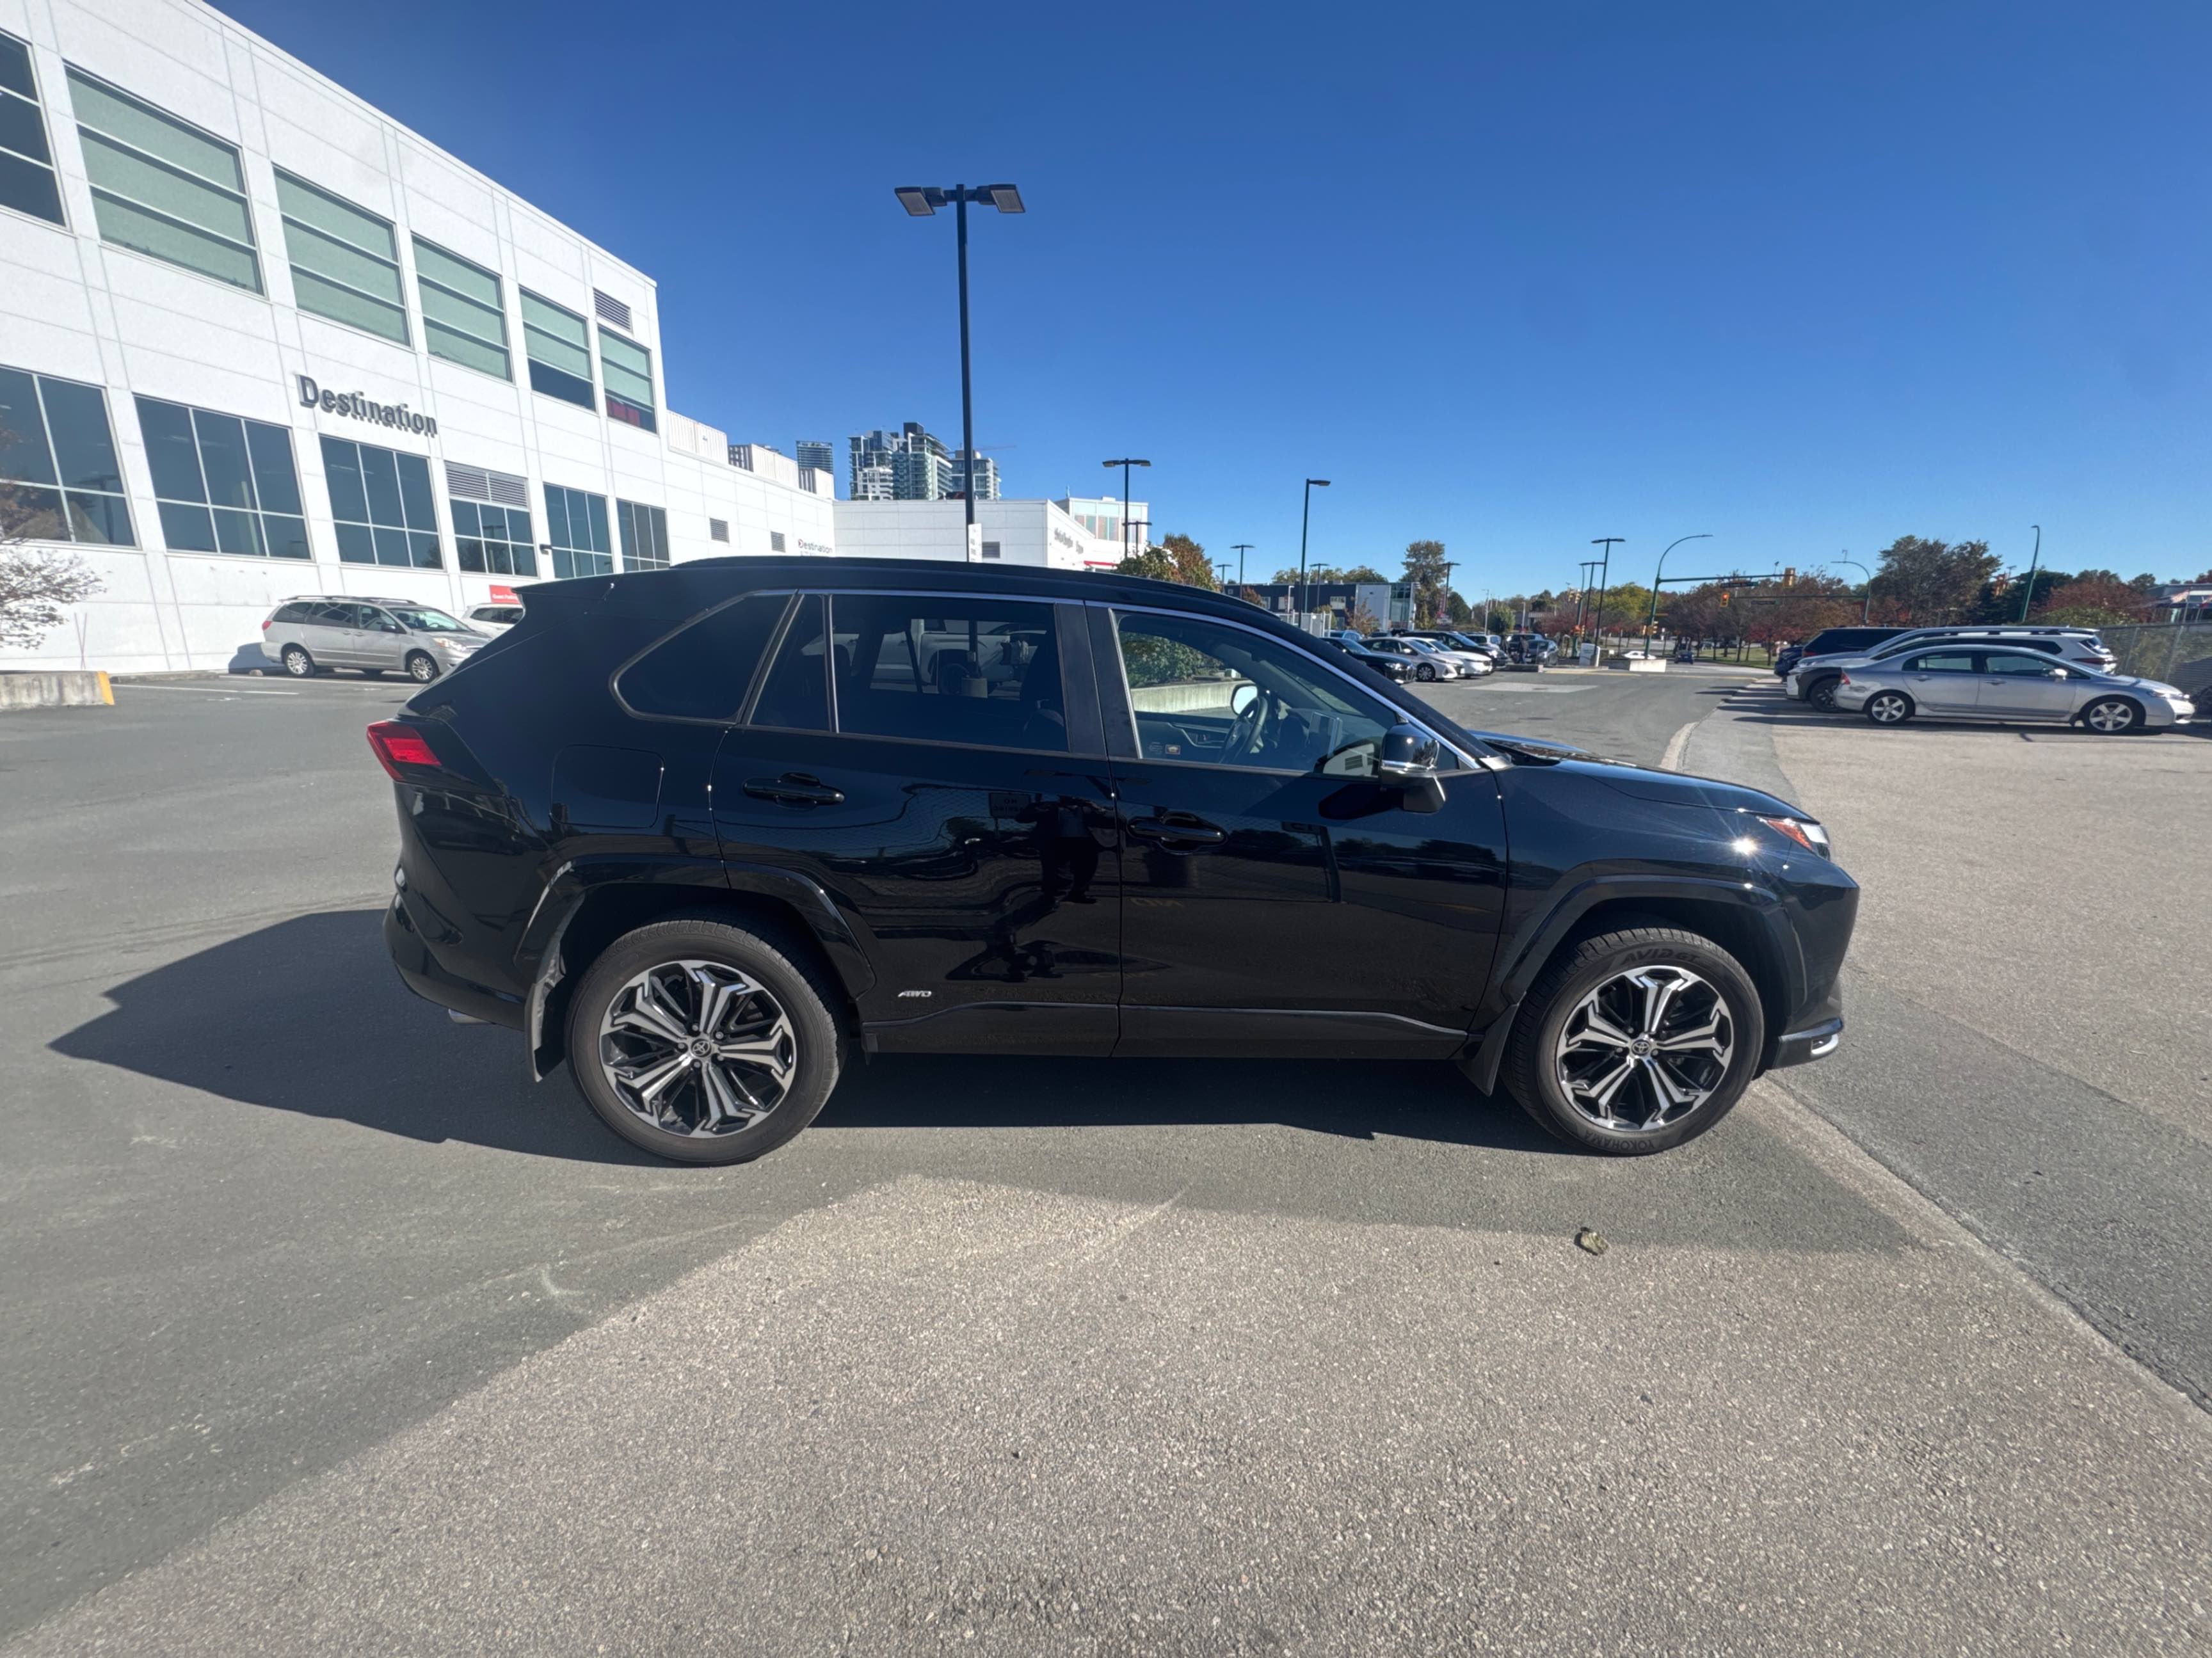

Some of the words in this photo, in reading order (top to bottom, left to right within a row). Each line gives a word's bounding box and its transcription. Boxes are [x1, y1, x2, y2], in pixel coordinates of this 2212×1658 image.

[296, 373, 438, 438] Destination
[797, 538, 833, 554] Destination
[1619, 948, 1674, 966] AVID
[1675, 952, 1700, 963] GT
[1584, 1128, 1655, 1152] YOKOHAMA
